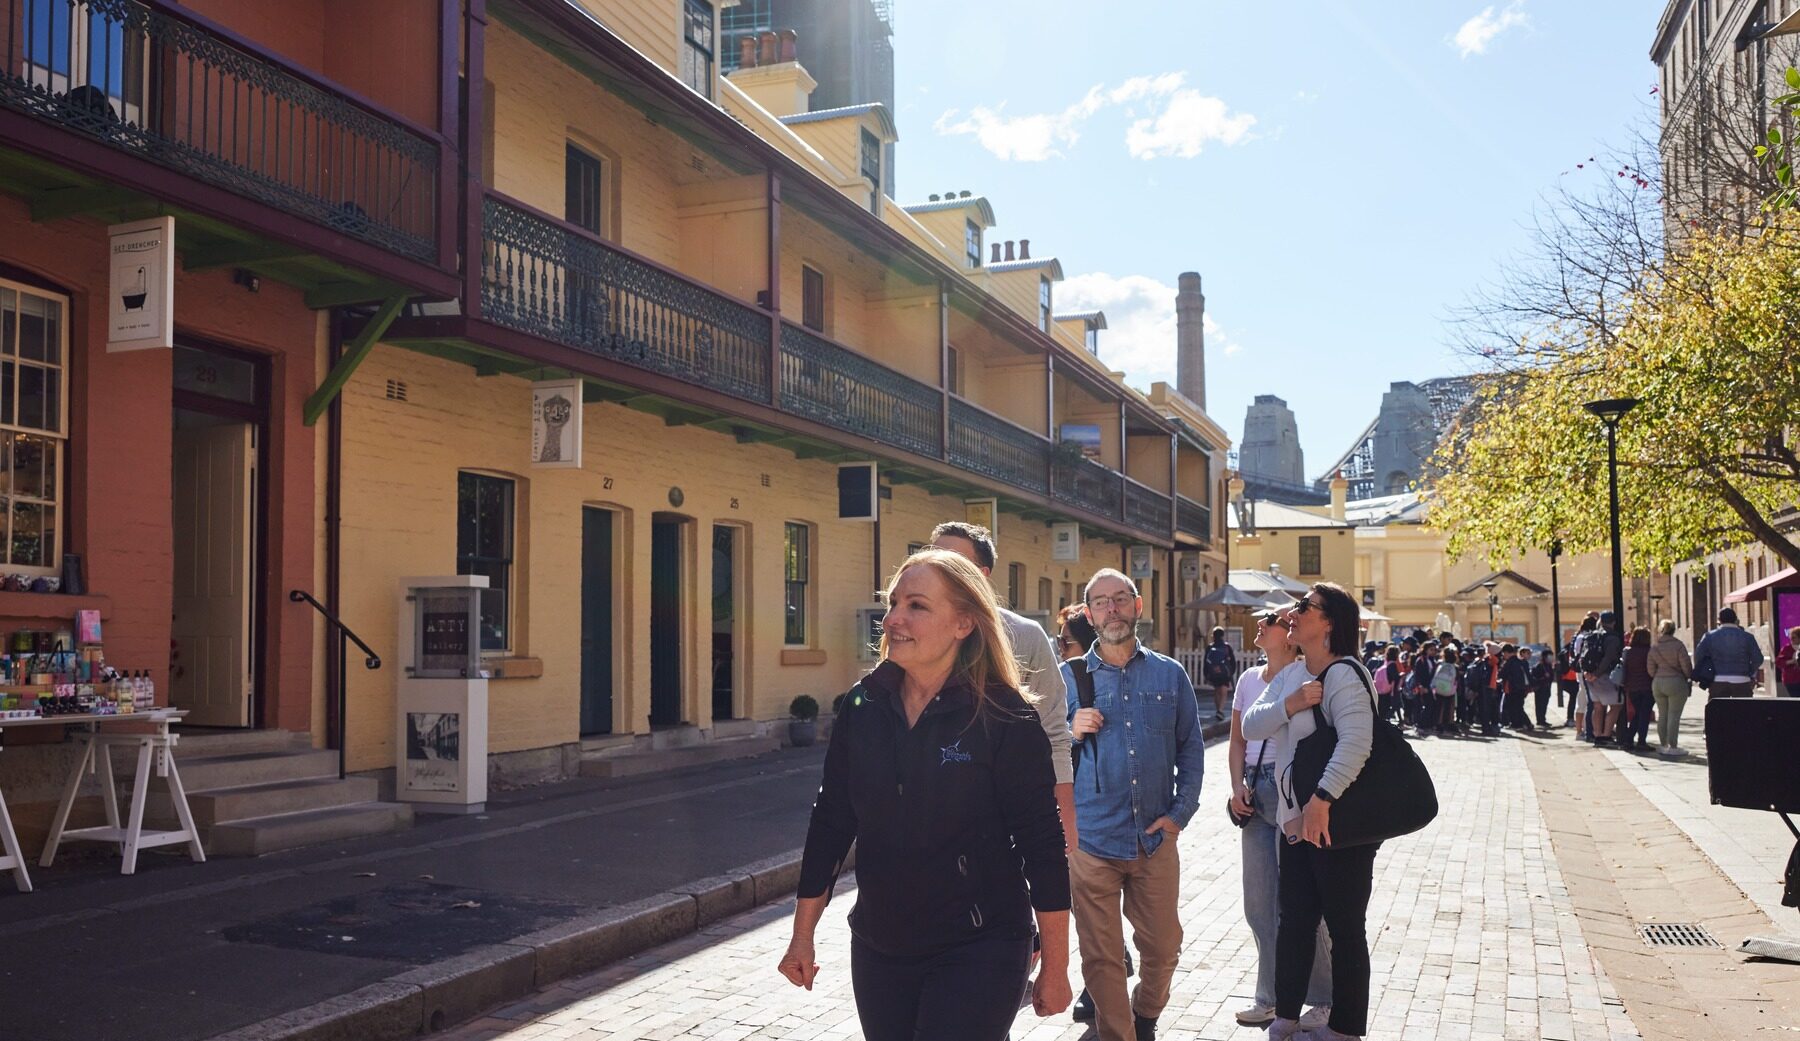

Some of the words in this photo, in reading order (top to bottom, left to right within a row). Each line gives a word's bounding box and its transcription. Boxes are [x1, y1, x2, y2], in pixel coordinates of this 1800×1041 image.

[127, 240, 159, 250] DRENCHED
[603, 477, 614, 490] 27
[730, 497, 740, 510] 25
[426, 619, 465, 632] ATTY
